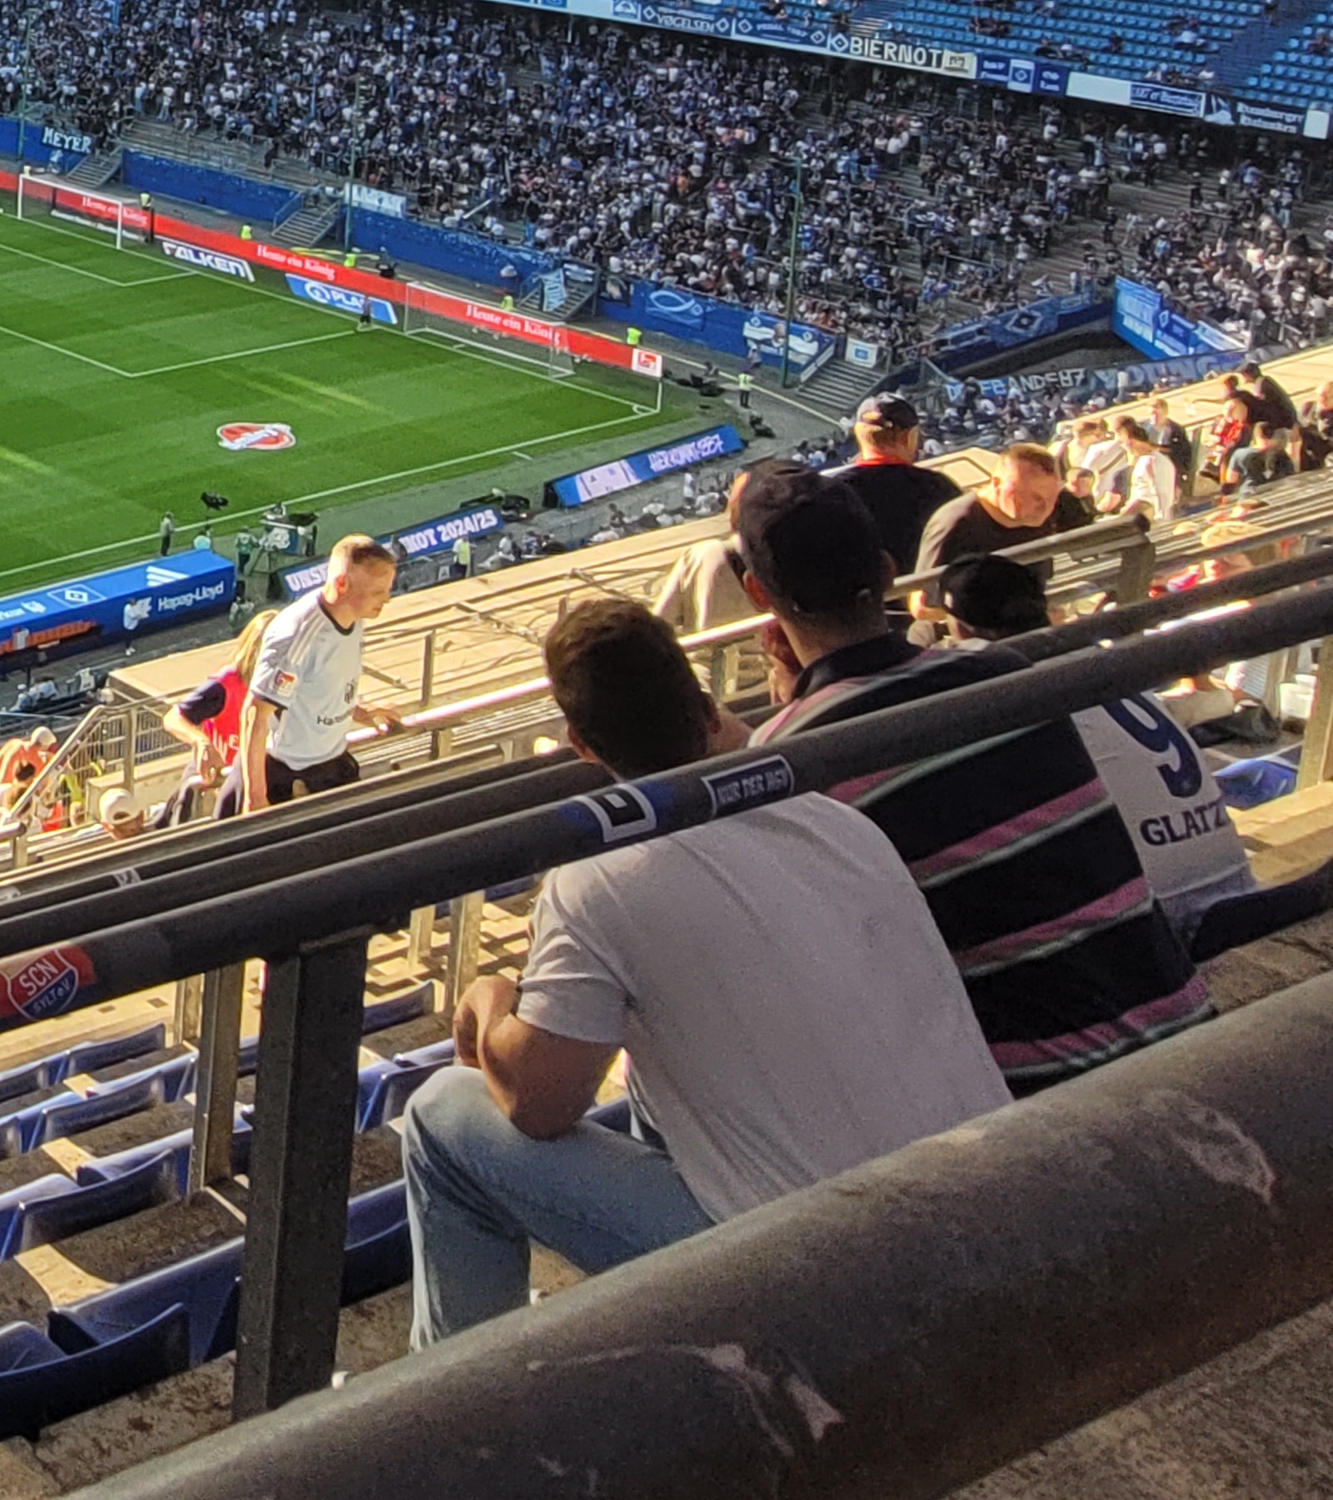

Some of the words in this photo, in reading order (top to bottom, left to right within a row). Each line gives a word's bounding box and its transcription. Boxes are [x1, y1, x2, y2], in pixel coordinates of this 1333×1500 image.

[42, 125, 92, 153] MEYER
[161, 241, 247, 279] FALKEN
[157, 580, 225, 612] Hapag-Lloyd
[1101, 698, 1203, 798] 9
[741, 774, 765, 798] DER
[18, 957, 59, 997] SCN
